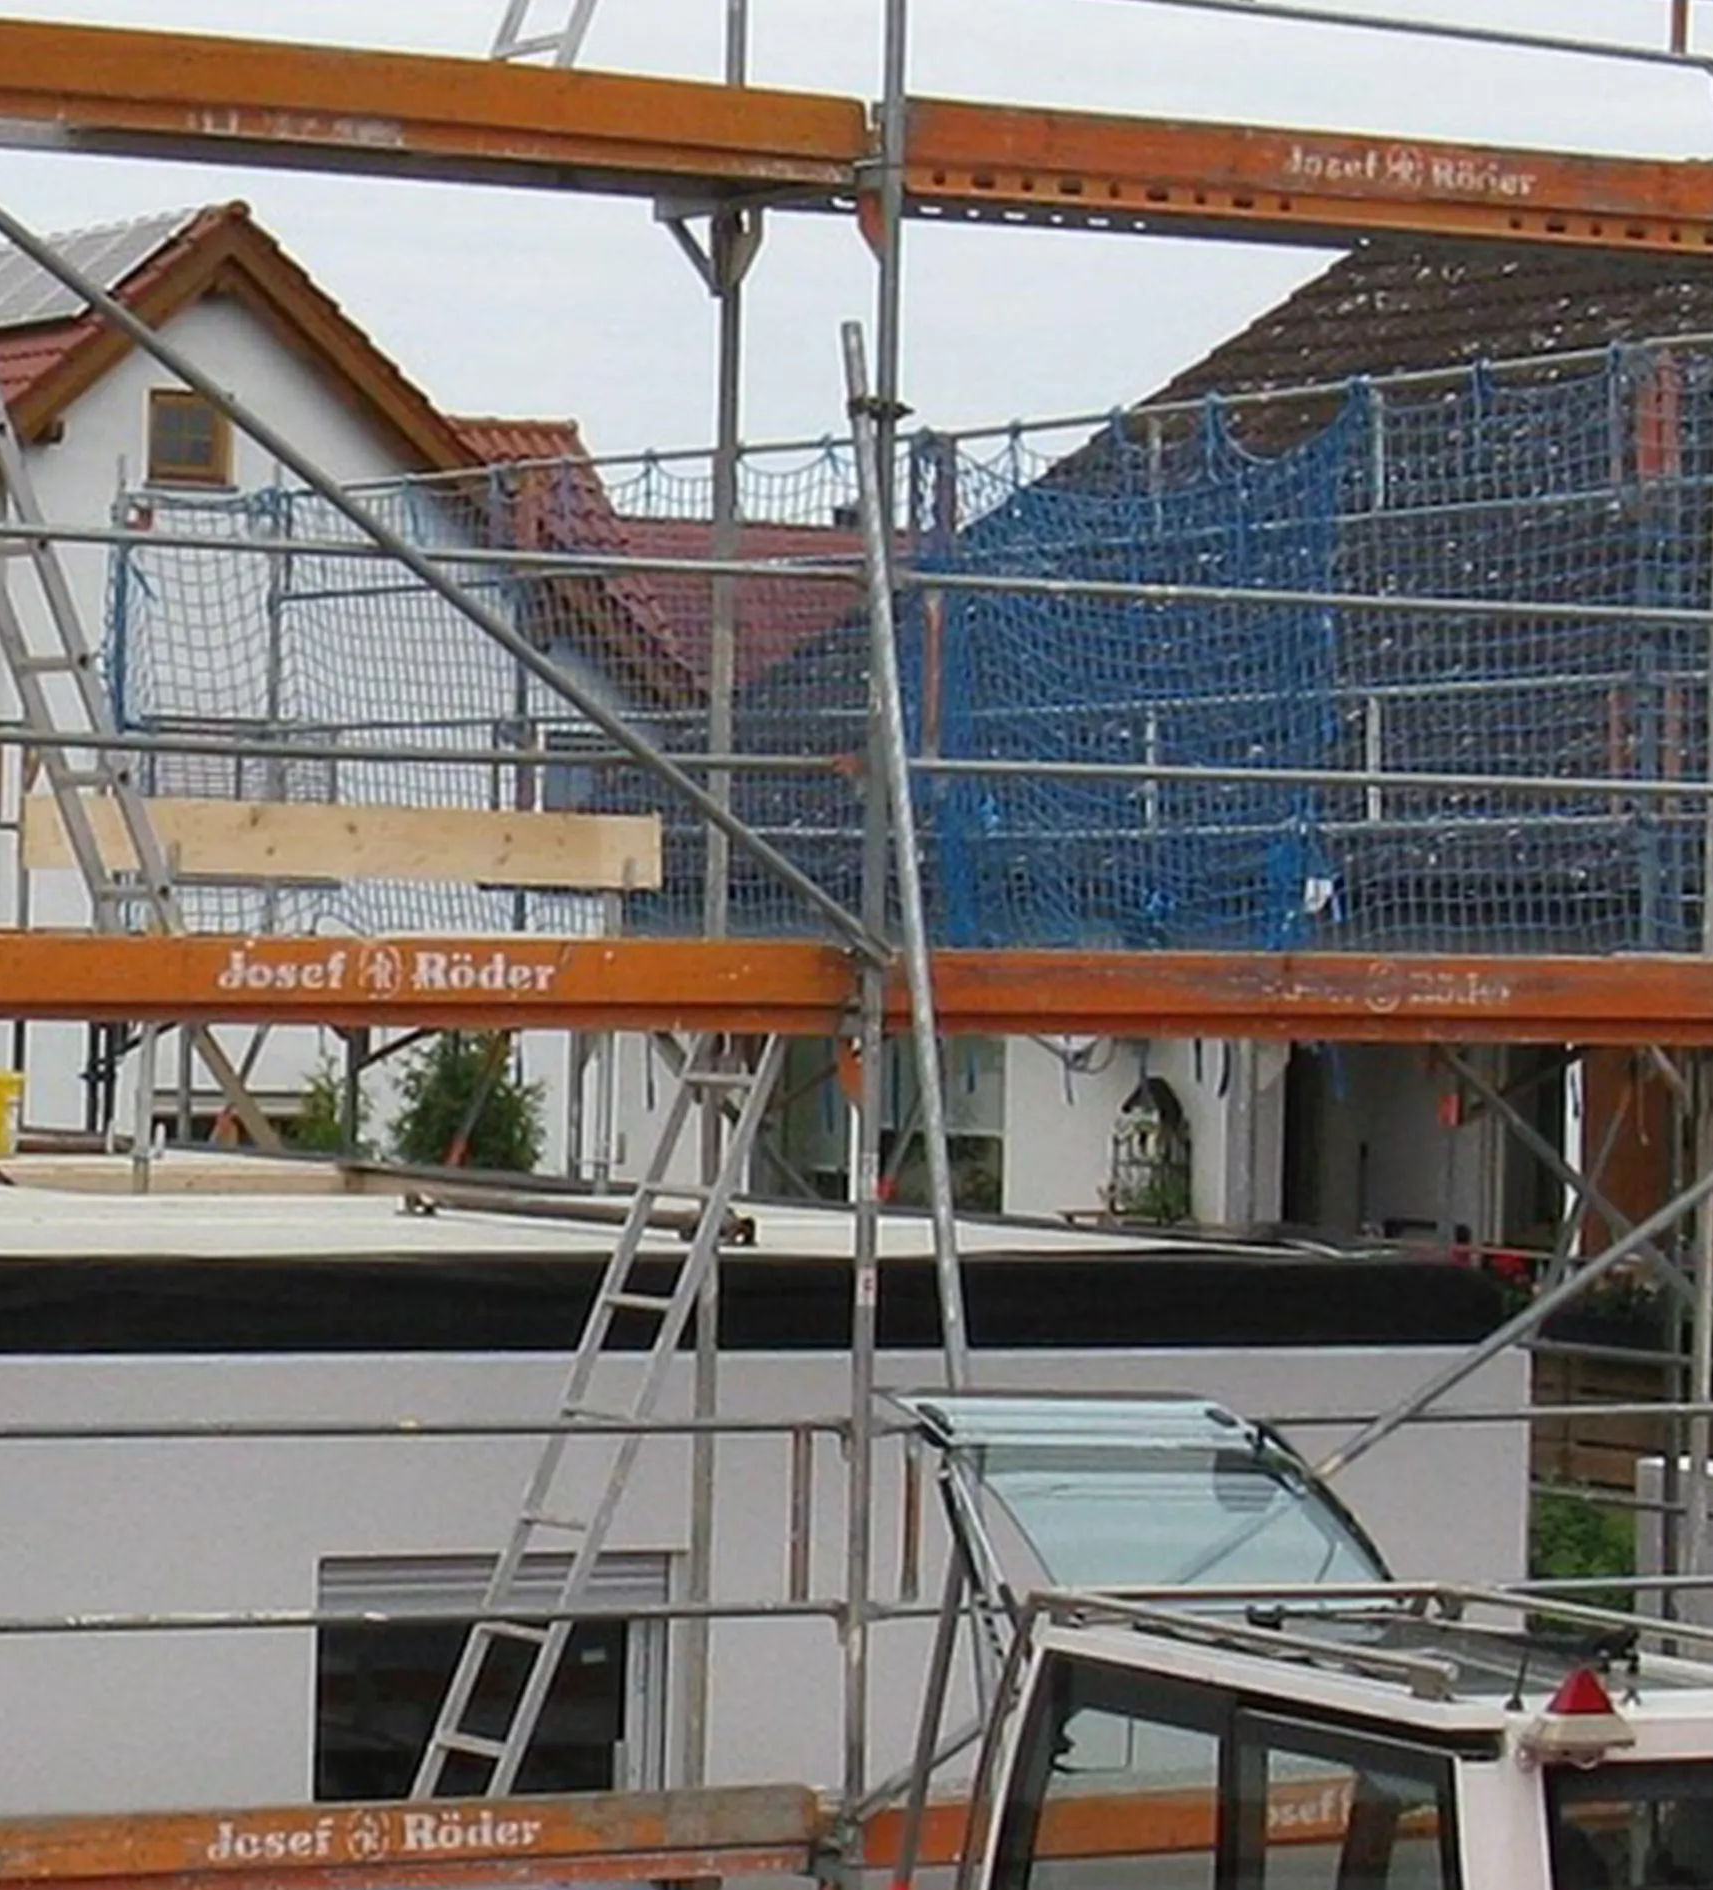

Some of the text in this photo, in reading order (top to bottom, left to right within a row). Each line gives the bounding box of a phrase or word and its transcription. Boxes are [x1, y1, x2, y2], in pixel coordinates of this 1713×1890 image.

[216, 949, 557, 992] Josef Röder
[1266, 1787, 1339, 1829] sef
[206, 1809, 542, 1862] Josef Röder
